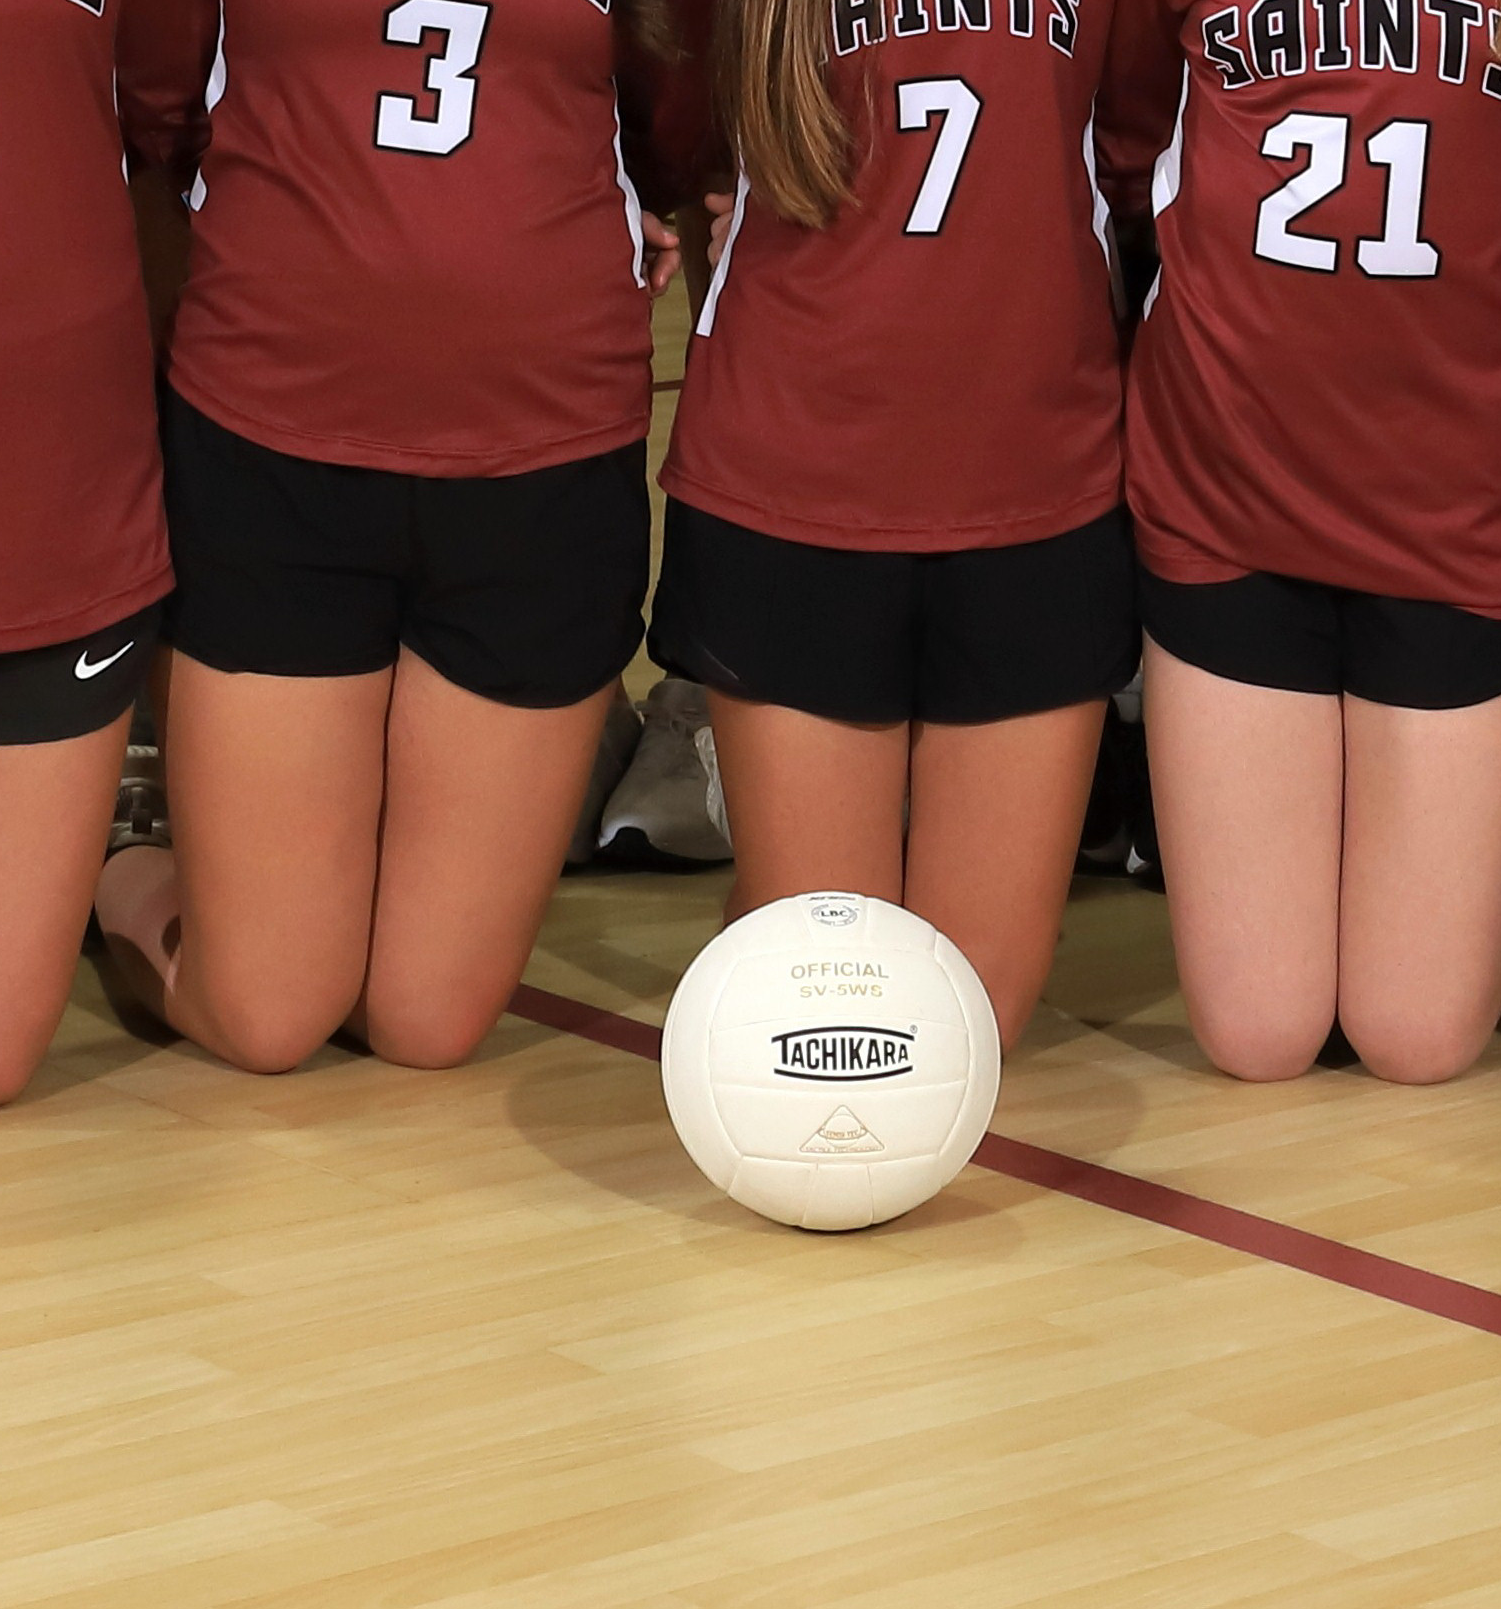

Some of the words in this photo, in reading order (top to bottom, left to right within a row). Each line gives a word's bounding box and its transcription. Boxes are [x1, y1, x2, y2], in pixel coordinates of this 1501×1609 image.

[895, 76, 984, 236] 7
[1253, 111, 1441, 278] 21
[790, 961, 890, 979] OFFICIAL
[799, 983, 884, 999] SV-5WS
[772, 1033, 909, 1072] TACHIKARA
